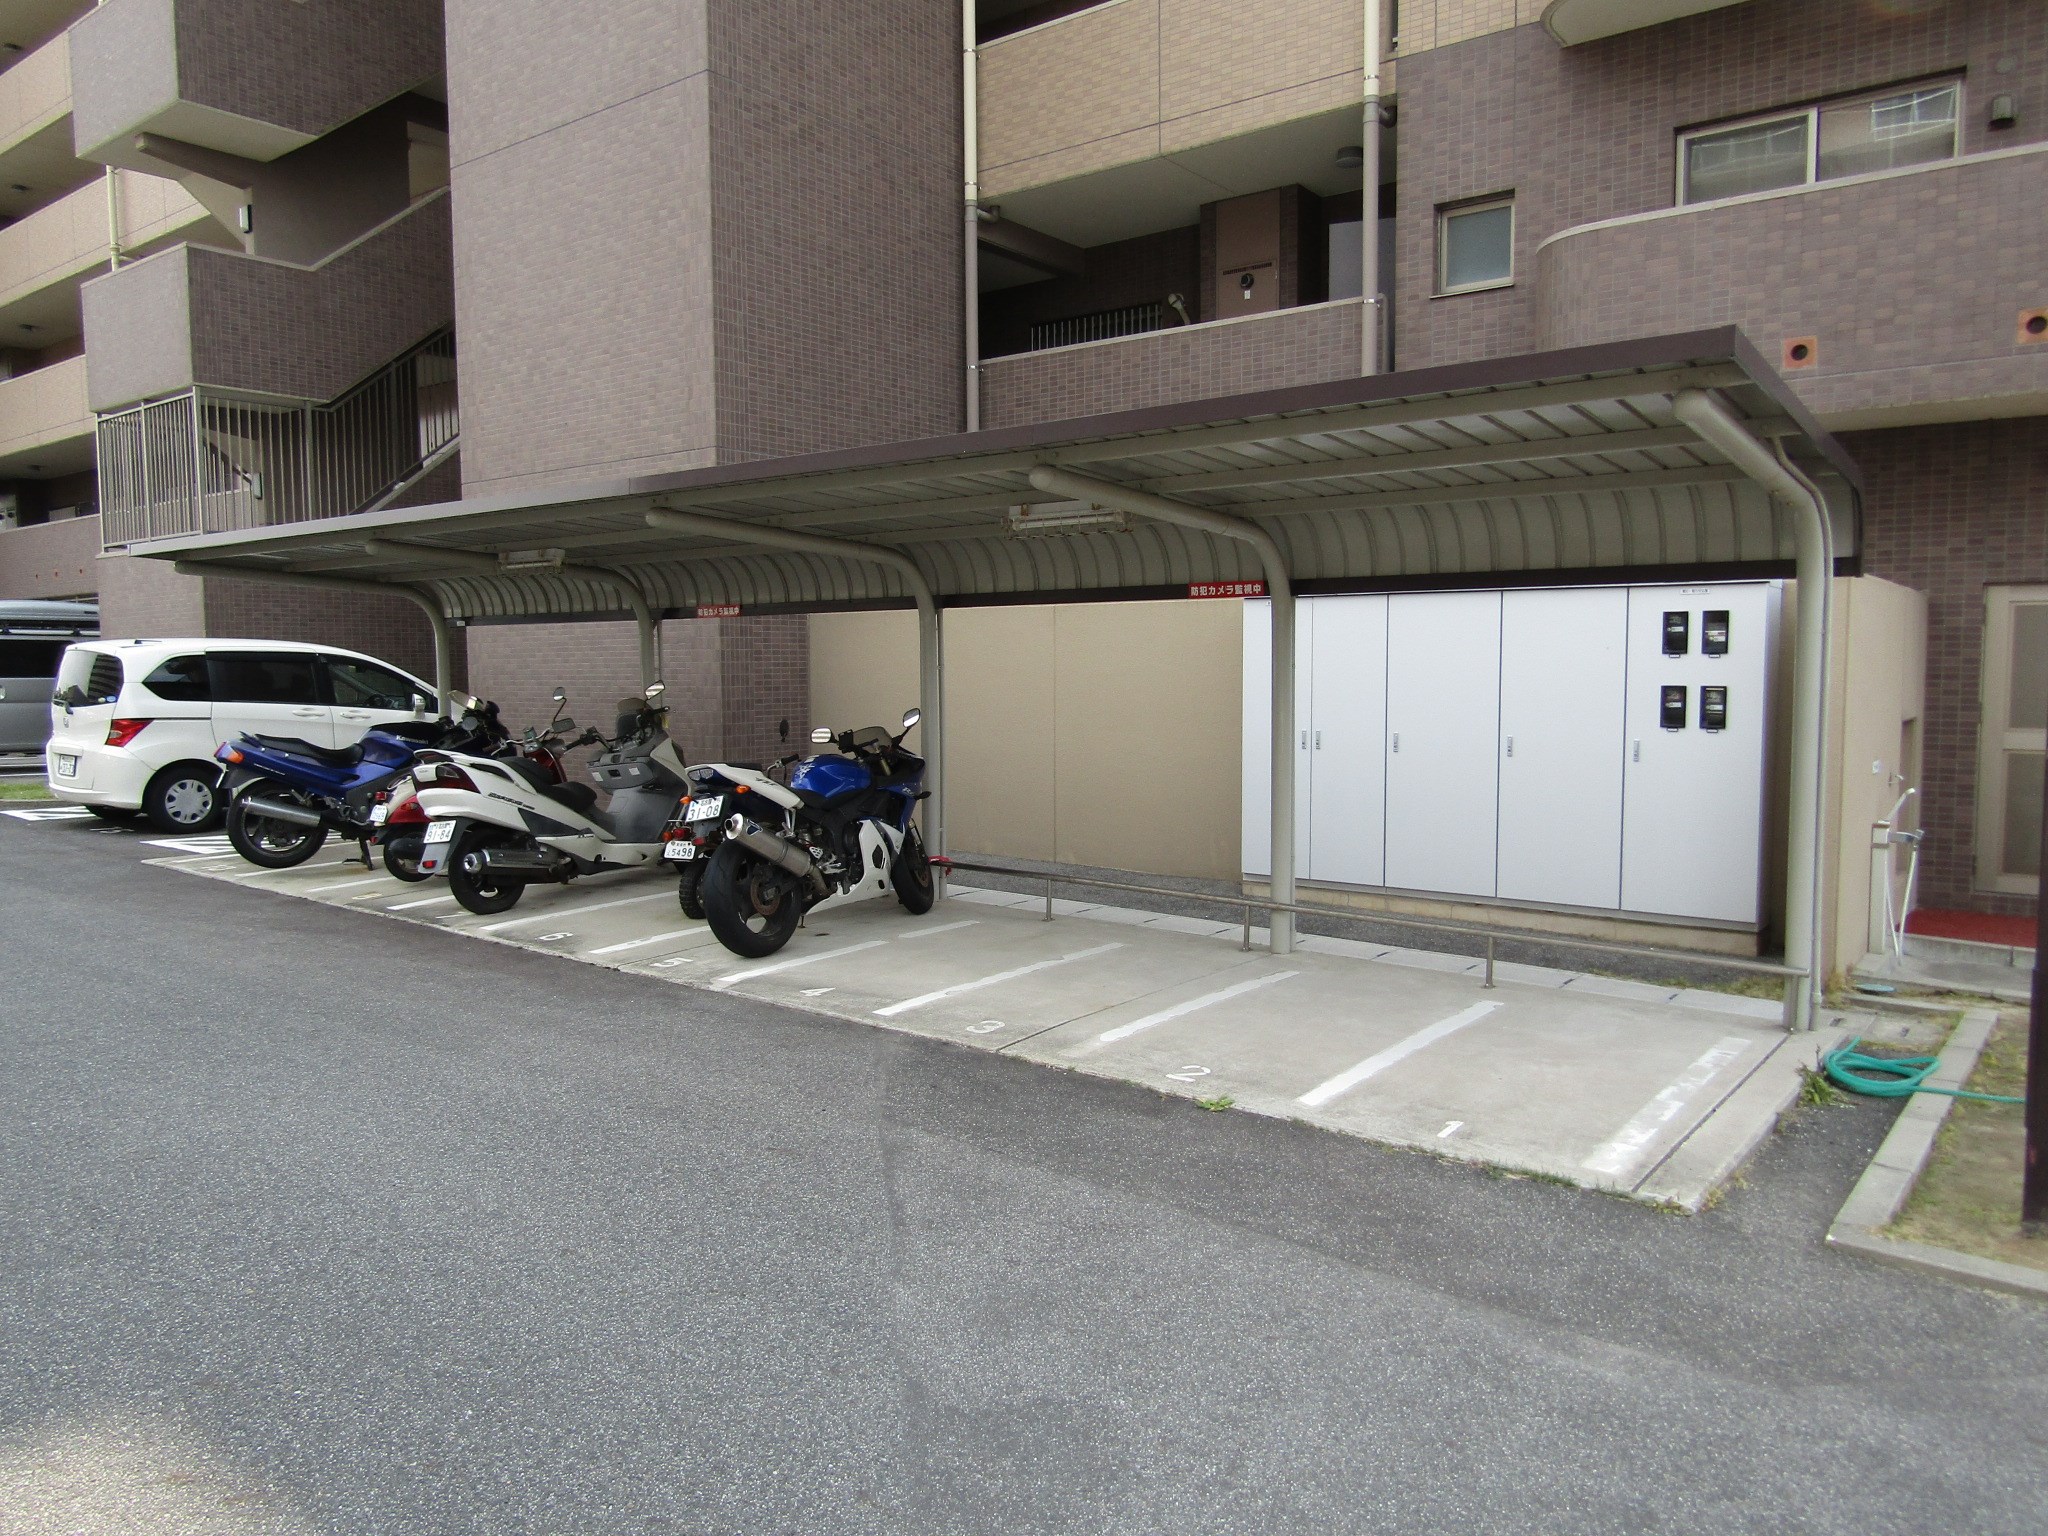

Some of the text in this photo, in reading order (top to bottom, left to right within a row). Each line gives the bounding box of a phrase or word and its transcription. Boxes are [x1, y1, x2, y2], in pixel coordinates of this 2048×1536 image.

[1190, 584, 1262, 596] 防犯カメラ監視中
[688, 804, 719, 820] 31-08
[427, 829, 451, 841] 91-84
[671, 848, 692, 857] 5498
[536, 932, 574, 941] 6
[649, 957, 693, 968] 5
[799, 987, 836, 997] 4
[965, 1020, 1005, 1034] 3
[1165, 1065, 1211, 1083] 2
[1437, 1120, 1464, 1138] 1
